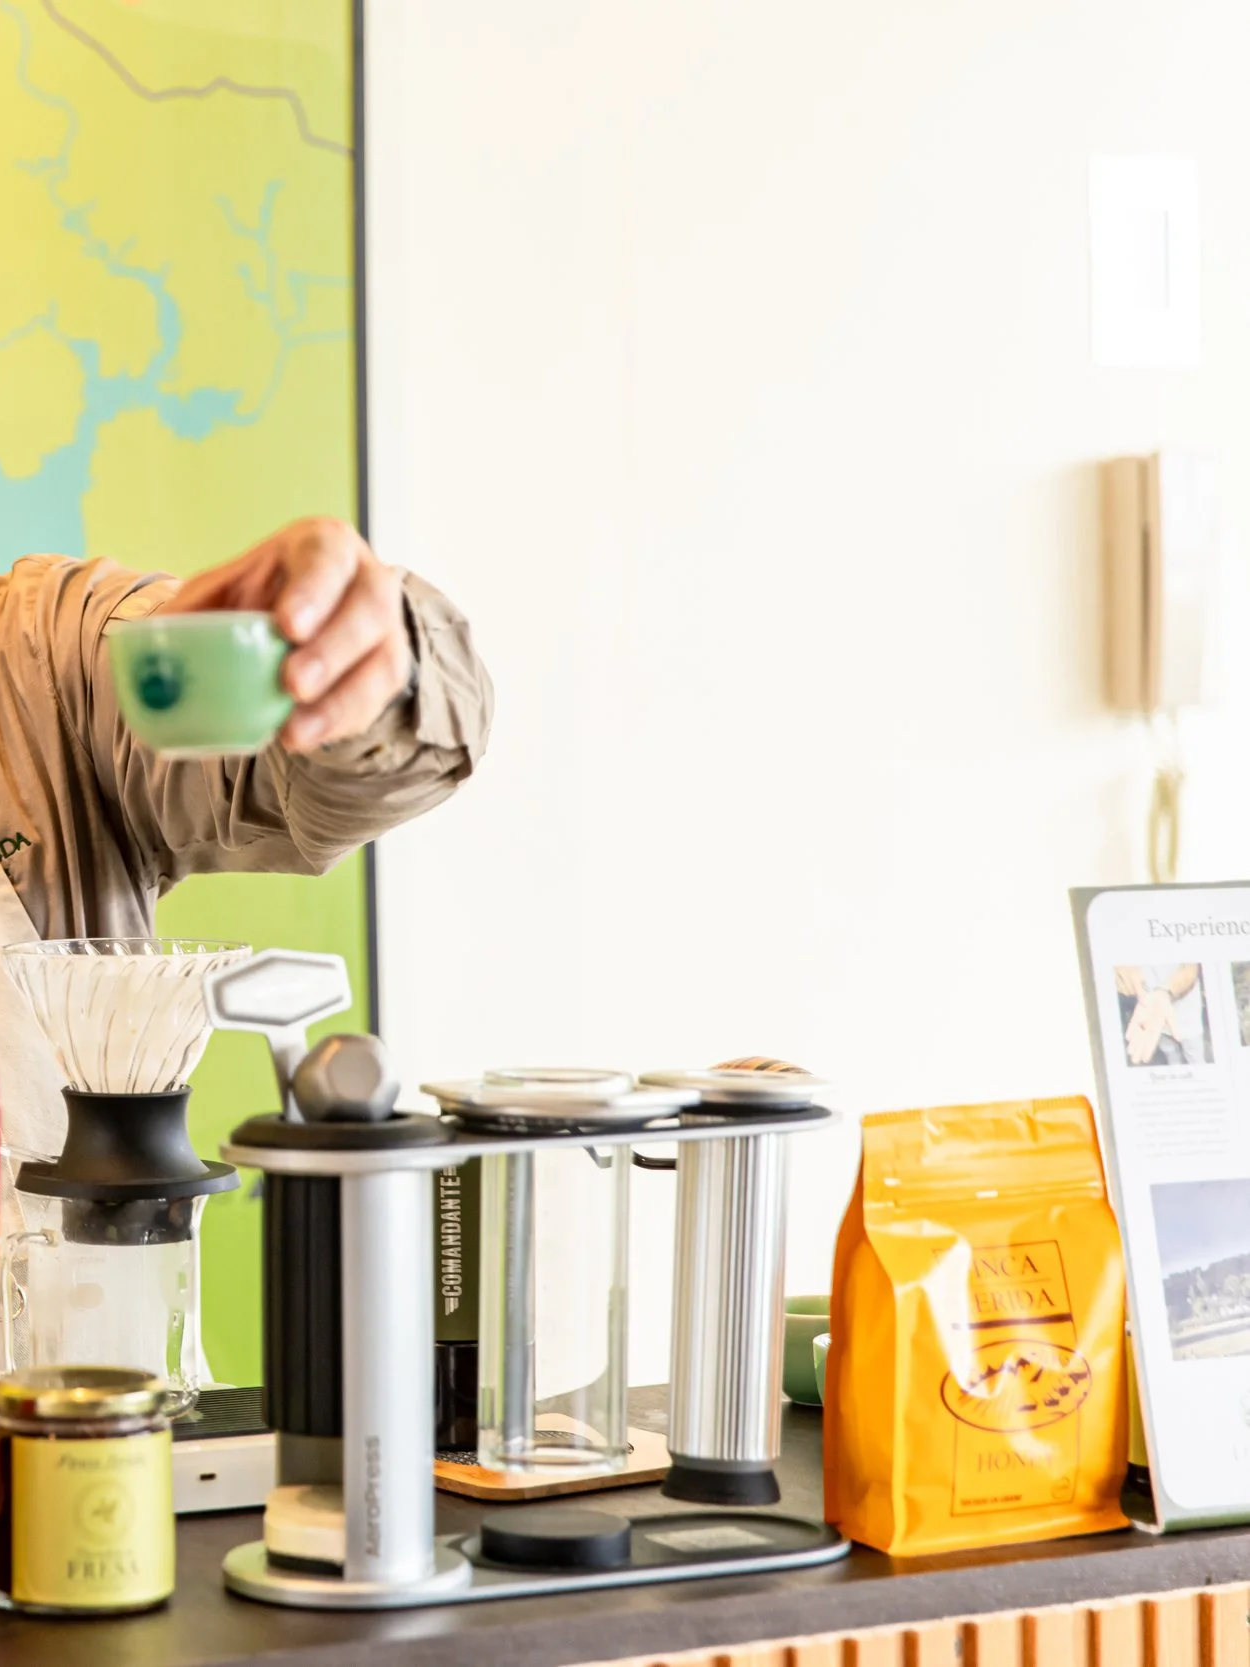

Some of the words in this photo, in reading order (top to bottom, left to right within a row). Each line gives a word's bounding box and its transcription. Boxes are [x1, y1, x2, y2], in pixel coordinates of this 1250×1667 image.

[440, 1177, 463, 1296] COMANDANTE
[972, 1254, 1040, 1279] INCA
[973, 1287, 1056, 1314] ERIDA
